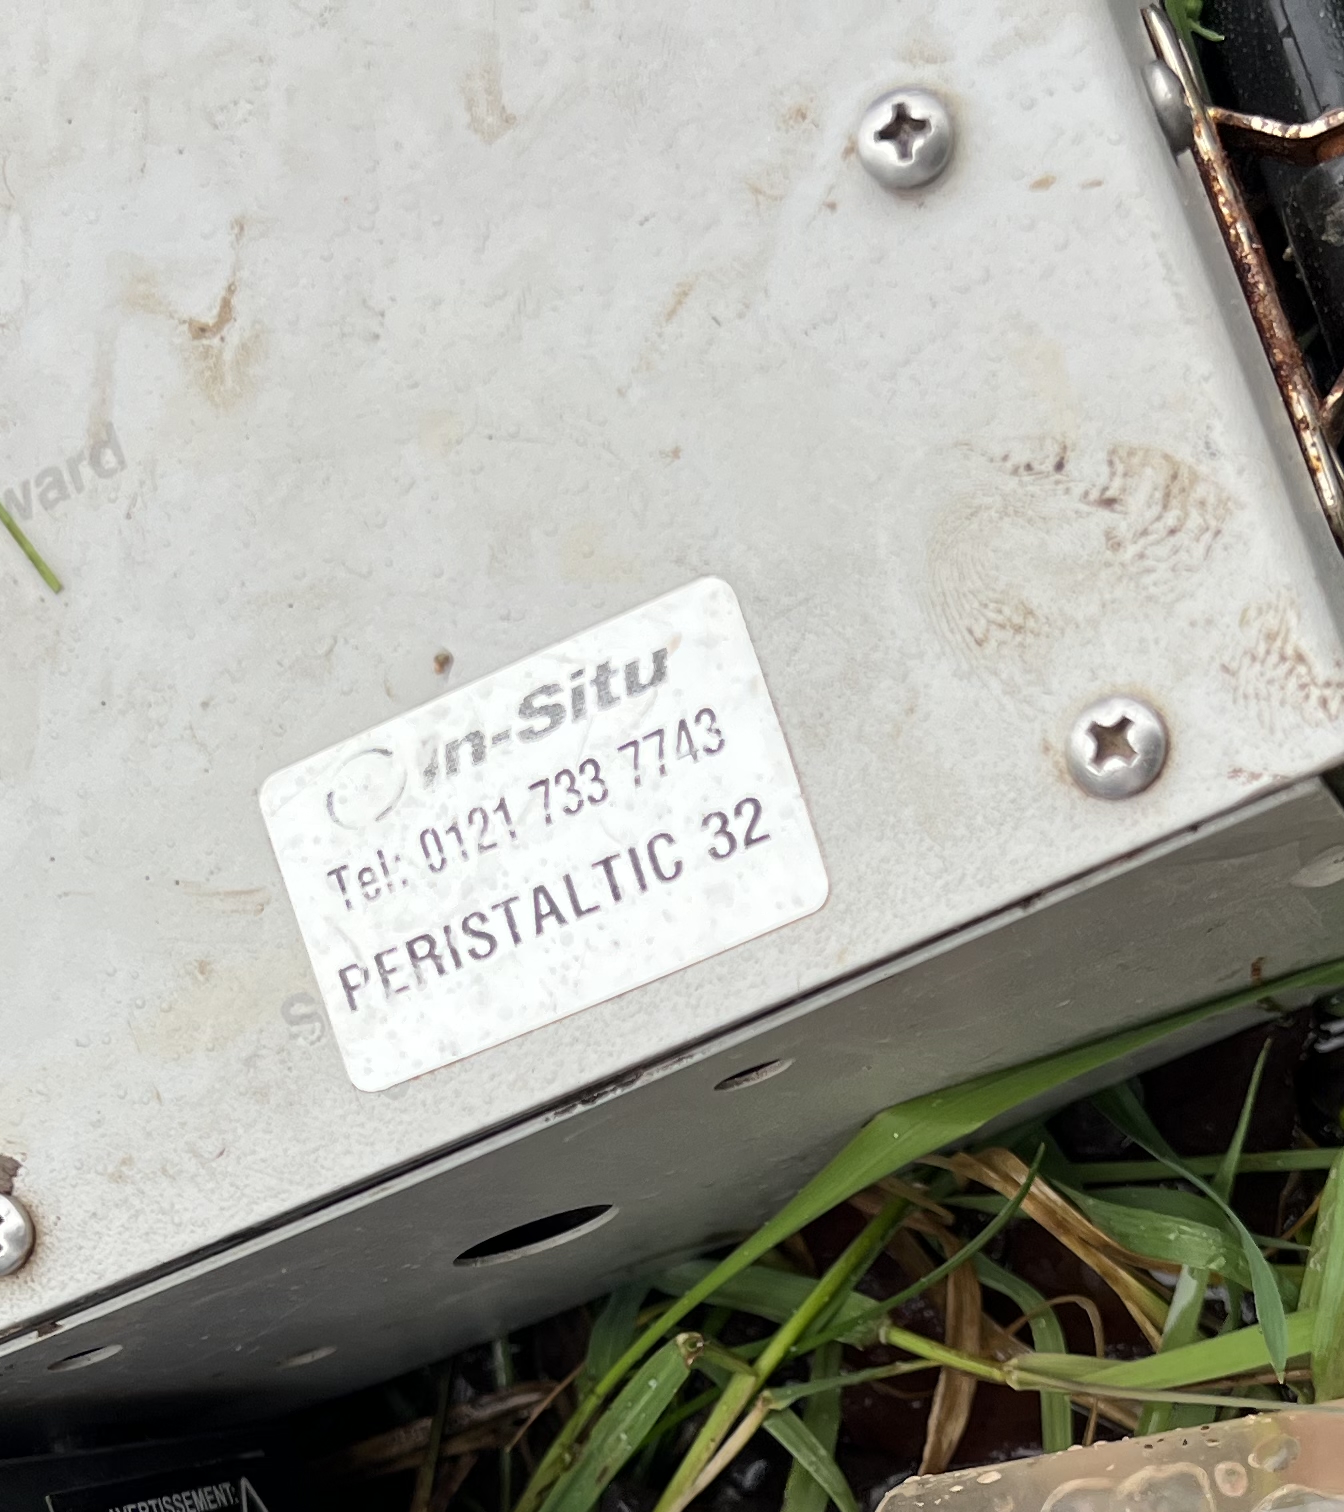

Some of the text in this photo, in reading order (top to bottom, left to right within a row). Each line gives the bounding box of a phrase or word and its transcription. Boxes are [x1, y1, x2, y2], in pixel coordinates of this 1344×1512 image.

[327, 706, 727, 911] Tel: 0121 733 7743
[337, 795, 771, 1013] PERISTALTIC 32
